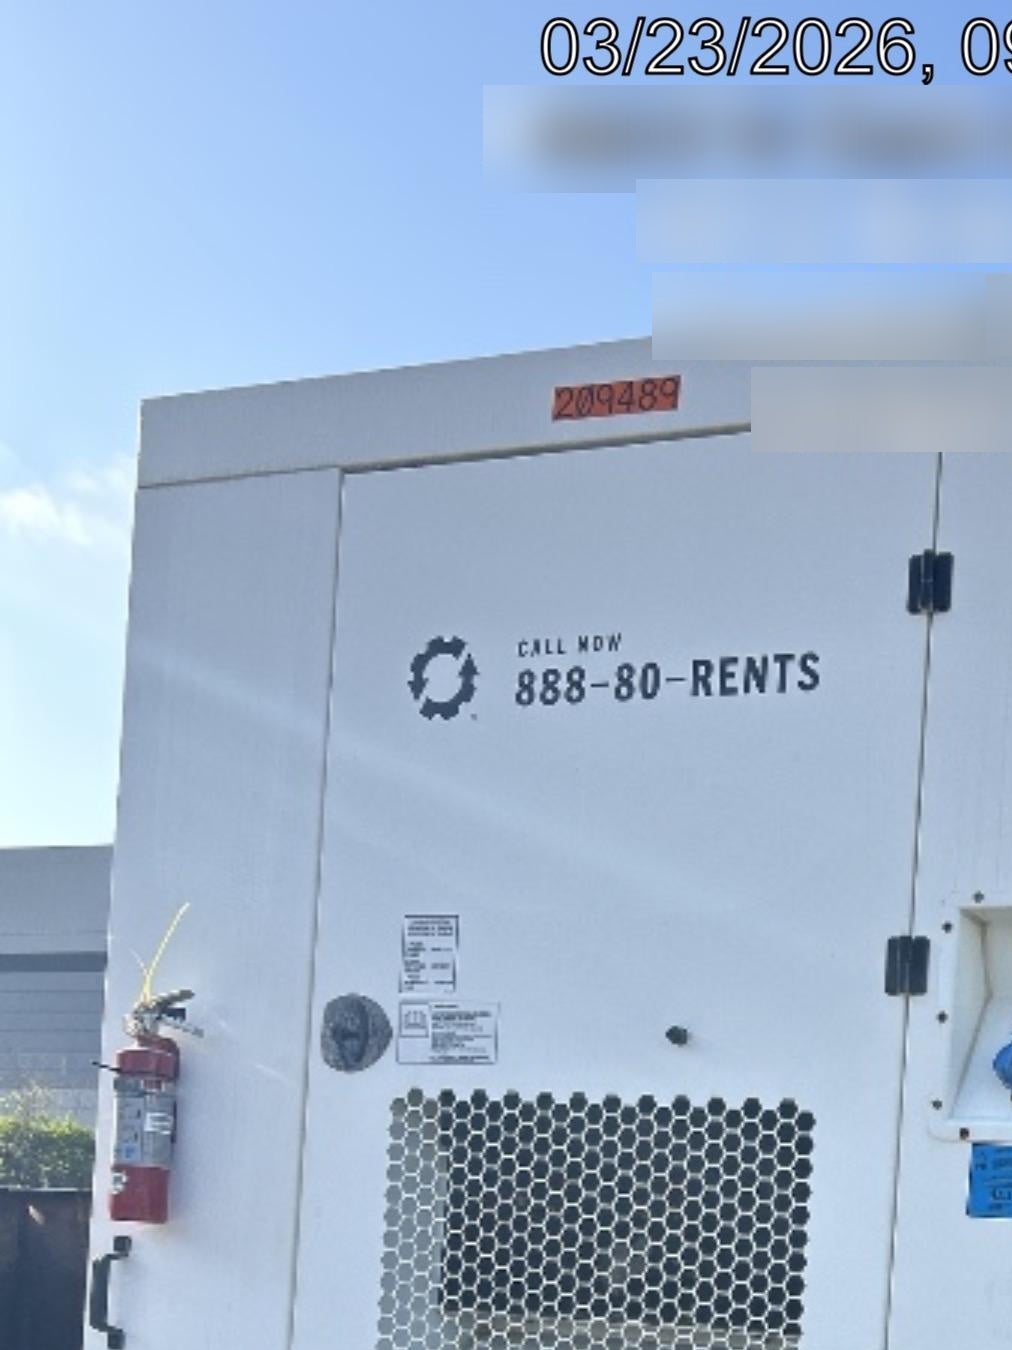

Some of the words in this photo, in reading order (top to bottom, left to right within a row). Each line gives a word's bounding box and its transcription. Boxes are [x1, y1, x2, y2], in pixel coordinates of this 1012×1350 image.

[555, 377, 680, 418] 209489
[517, 637, 567, 658] CALL
[577, 632, 623, 654] NOW
[515, 651, 821, 707] 888-80-RENTS
